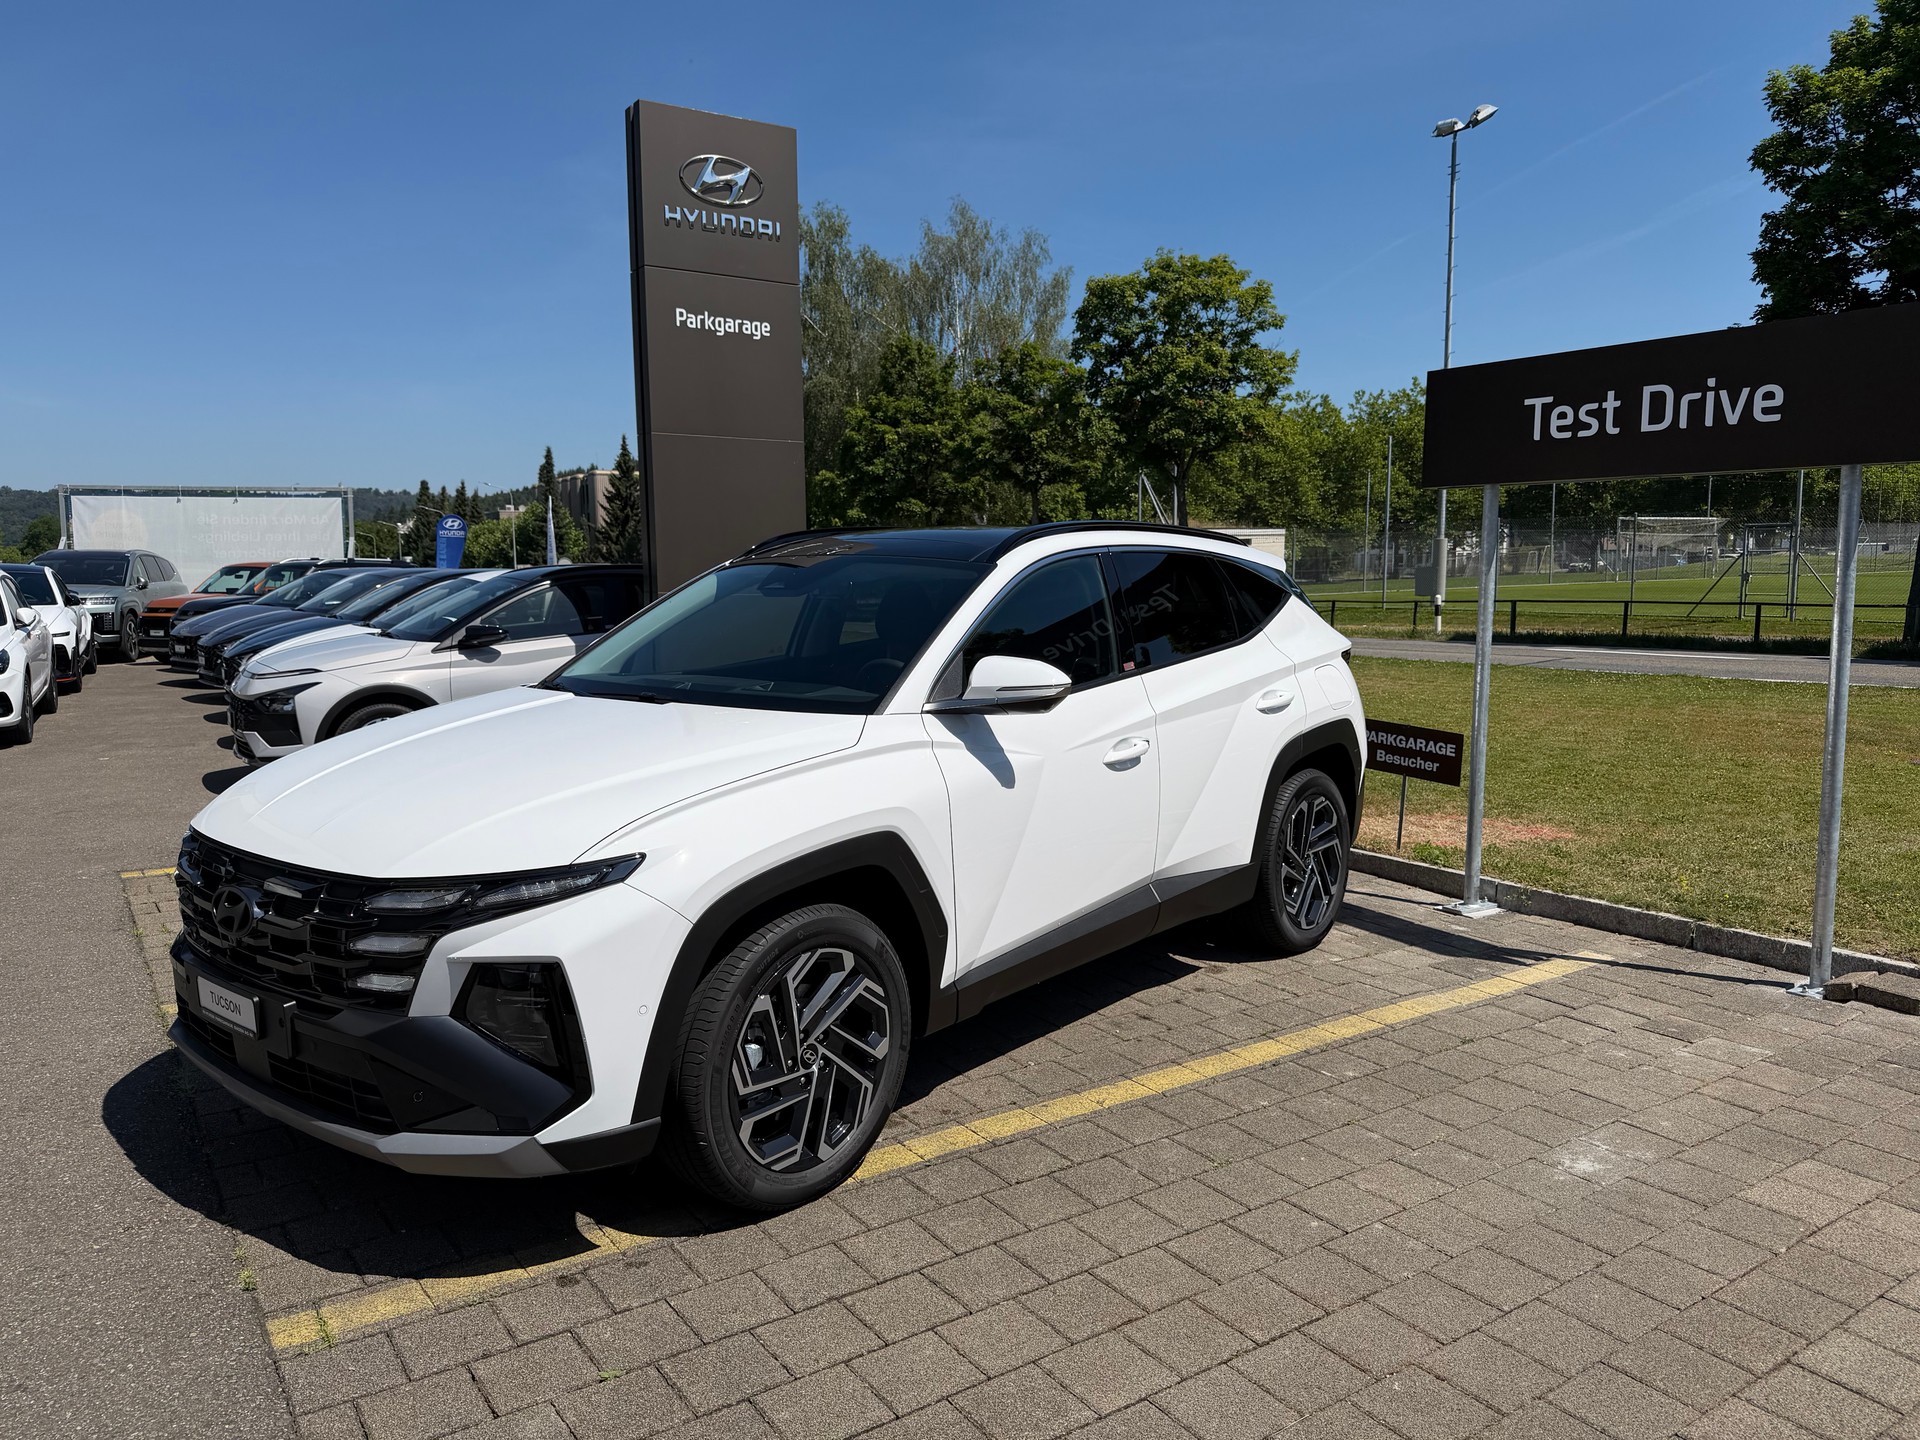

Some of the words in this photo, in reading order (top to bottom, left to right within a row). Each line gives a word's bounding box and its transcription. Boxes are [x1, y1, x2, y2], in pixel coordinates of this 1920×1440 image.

[664, 204, 781, 242] HYUNDAI
[675, 307, 771, 340] Parkgarage
[1524, 390, 1621, 441] Test
[1640, 377, 1784, 432] Drive
[1376, 749, 1440, 772] Besucher
[210, 991, 241, 1016] TUCSON
